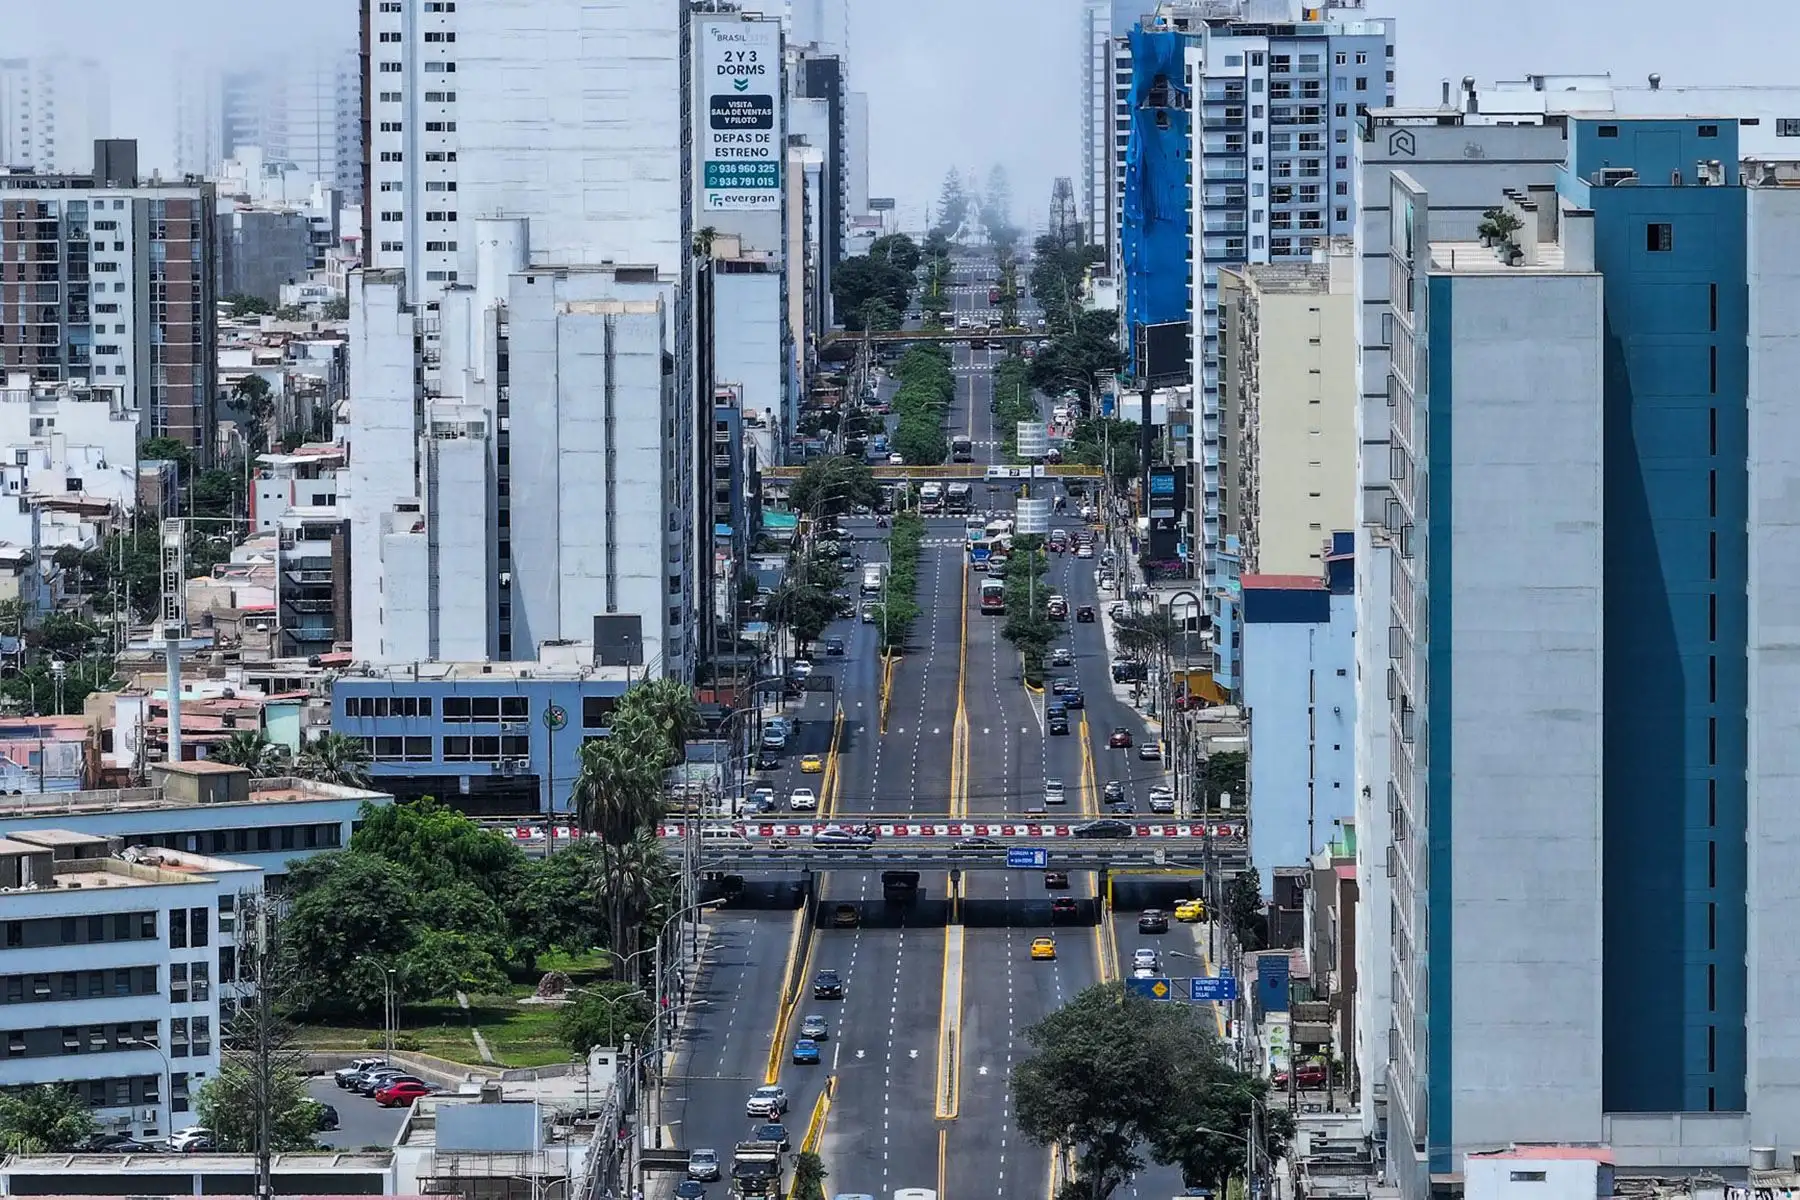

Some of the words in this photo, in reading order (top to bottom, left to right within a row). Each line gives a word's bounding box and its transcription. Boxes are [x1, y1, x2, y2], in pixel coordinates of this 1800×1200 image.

[724, 50, 733, 62] 2
[736, 51, 745, 62] Y
[749, 50, 757, 62] 3
[717, 64, 765, 75] DORMS
[713, 133, 752, 142] DEPAS
[755, 133, 770, 142] DE
[715, 147, 769, 156] ESTRENO
[718, 164, 737, 173] 936
[758, 164, 775, 173] 325
[719, 177, 738, 186] 936
[757, 177, 774, 186] 015
[724, 194, 774, 203] evergran
